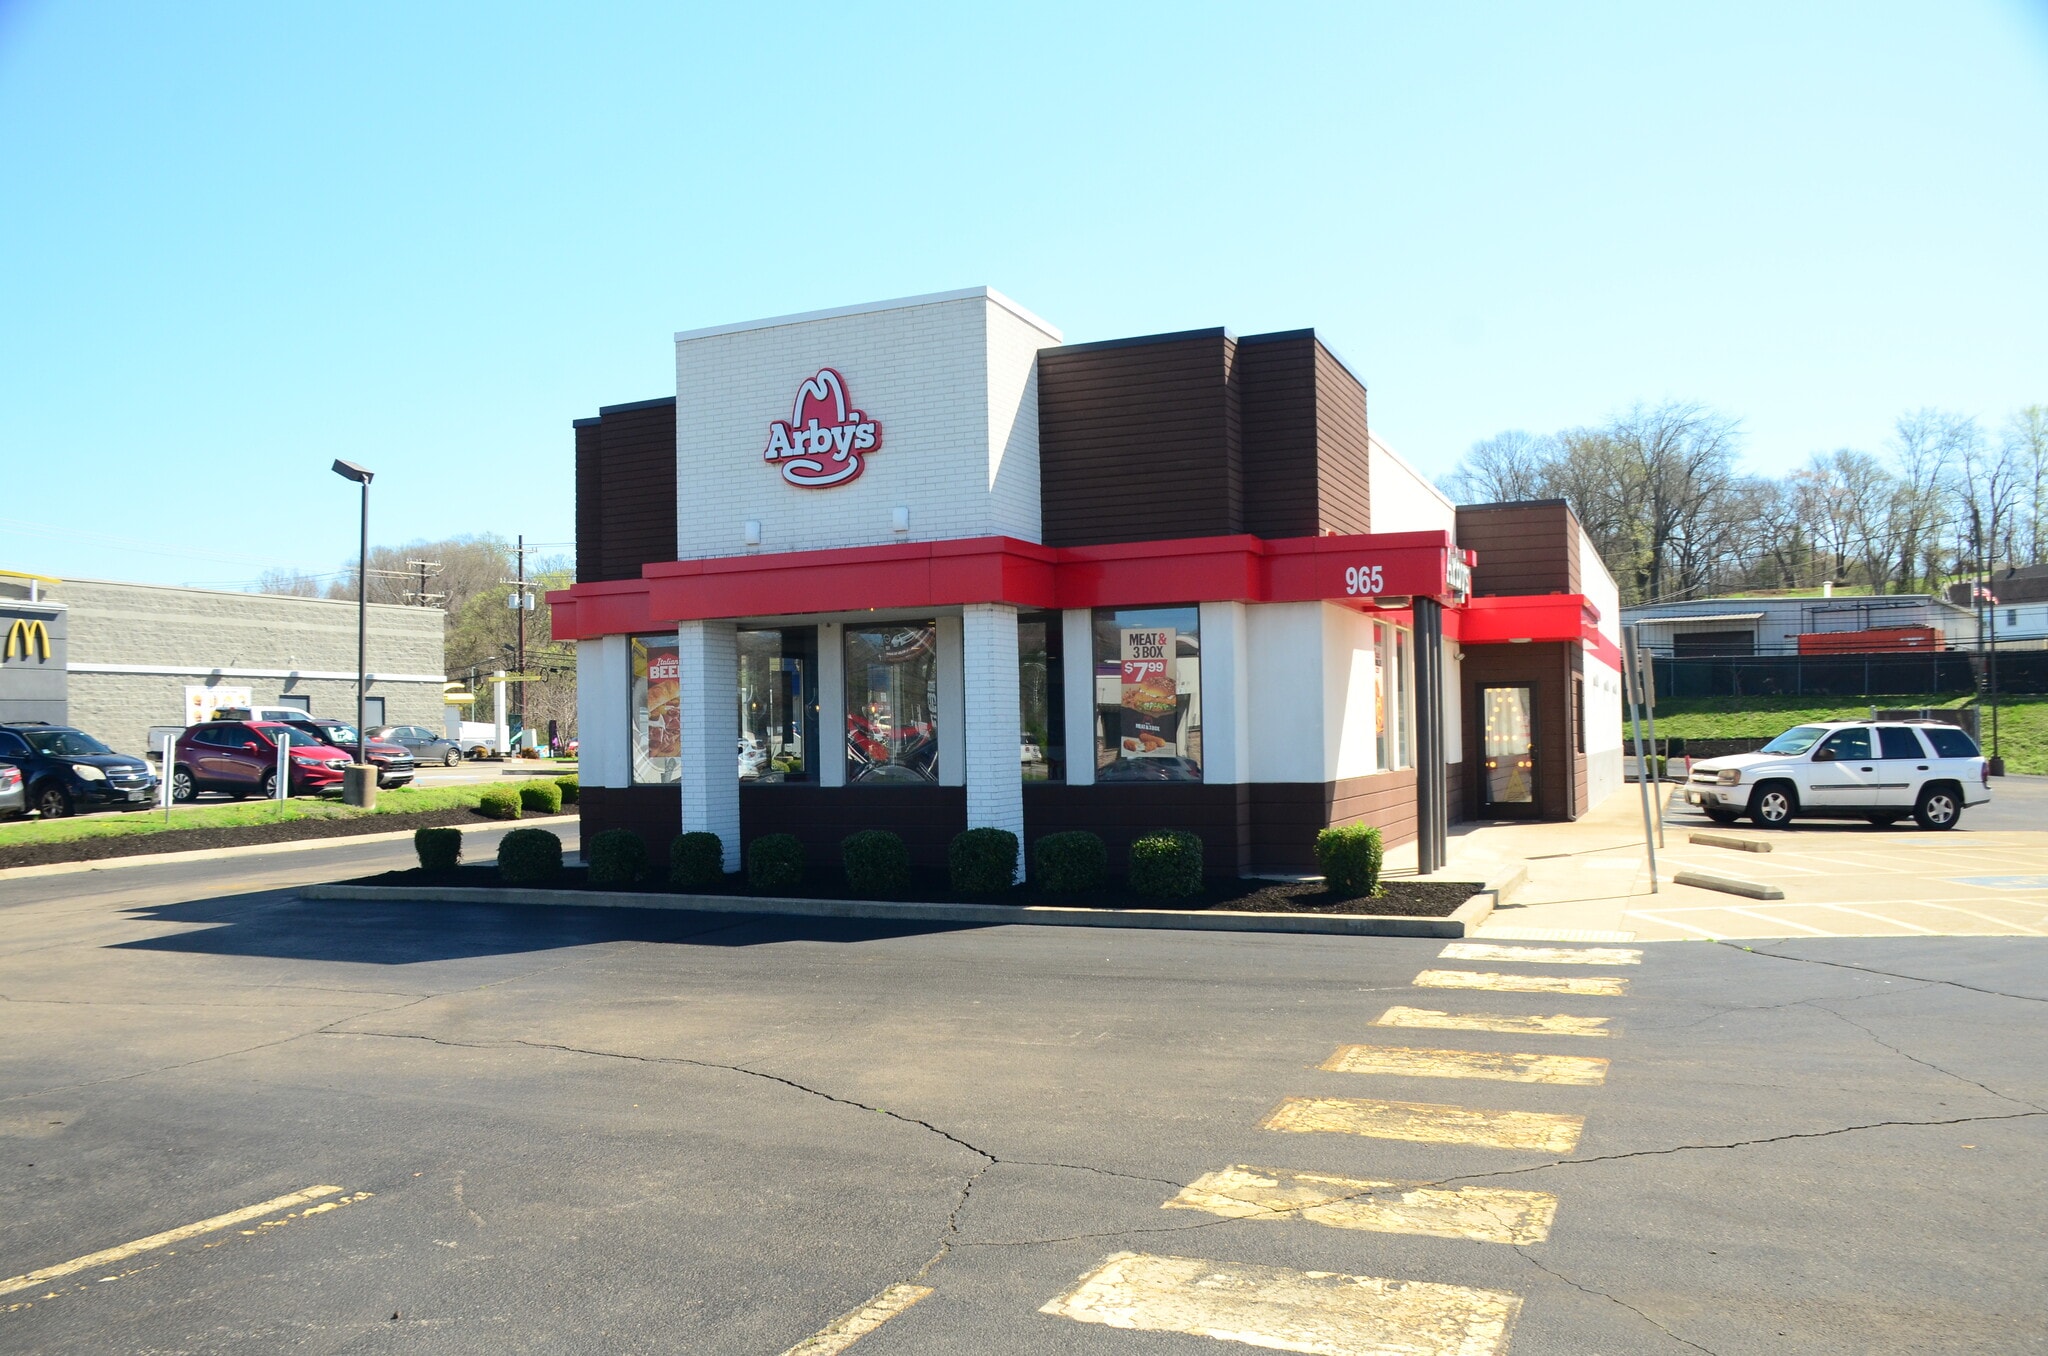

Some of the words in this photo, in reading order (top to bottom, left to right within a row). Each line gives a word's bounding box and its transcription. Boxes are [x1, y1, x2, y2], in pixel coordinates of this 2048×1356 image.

[765, 412, 876, 461] Arby's
[1345, 565, 1384, 595] 965
[1133, 646, 1140, 658] 3
[1142, 646, 1164, 658] BOX
[650, 666, 680, 679] BEE
